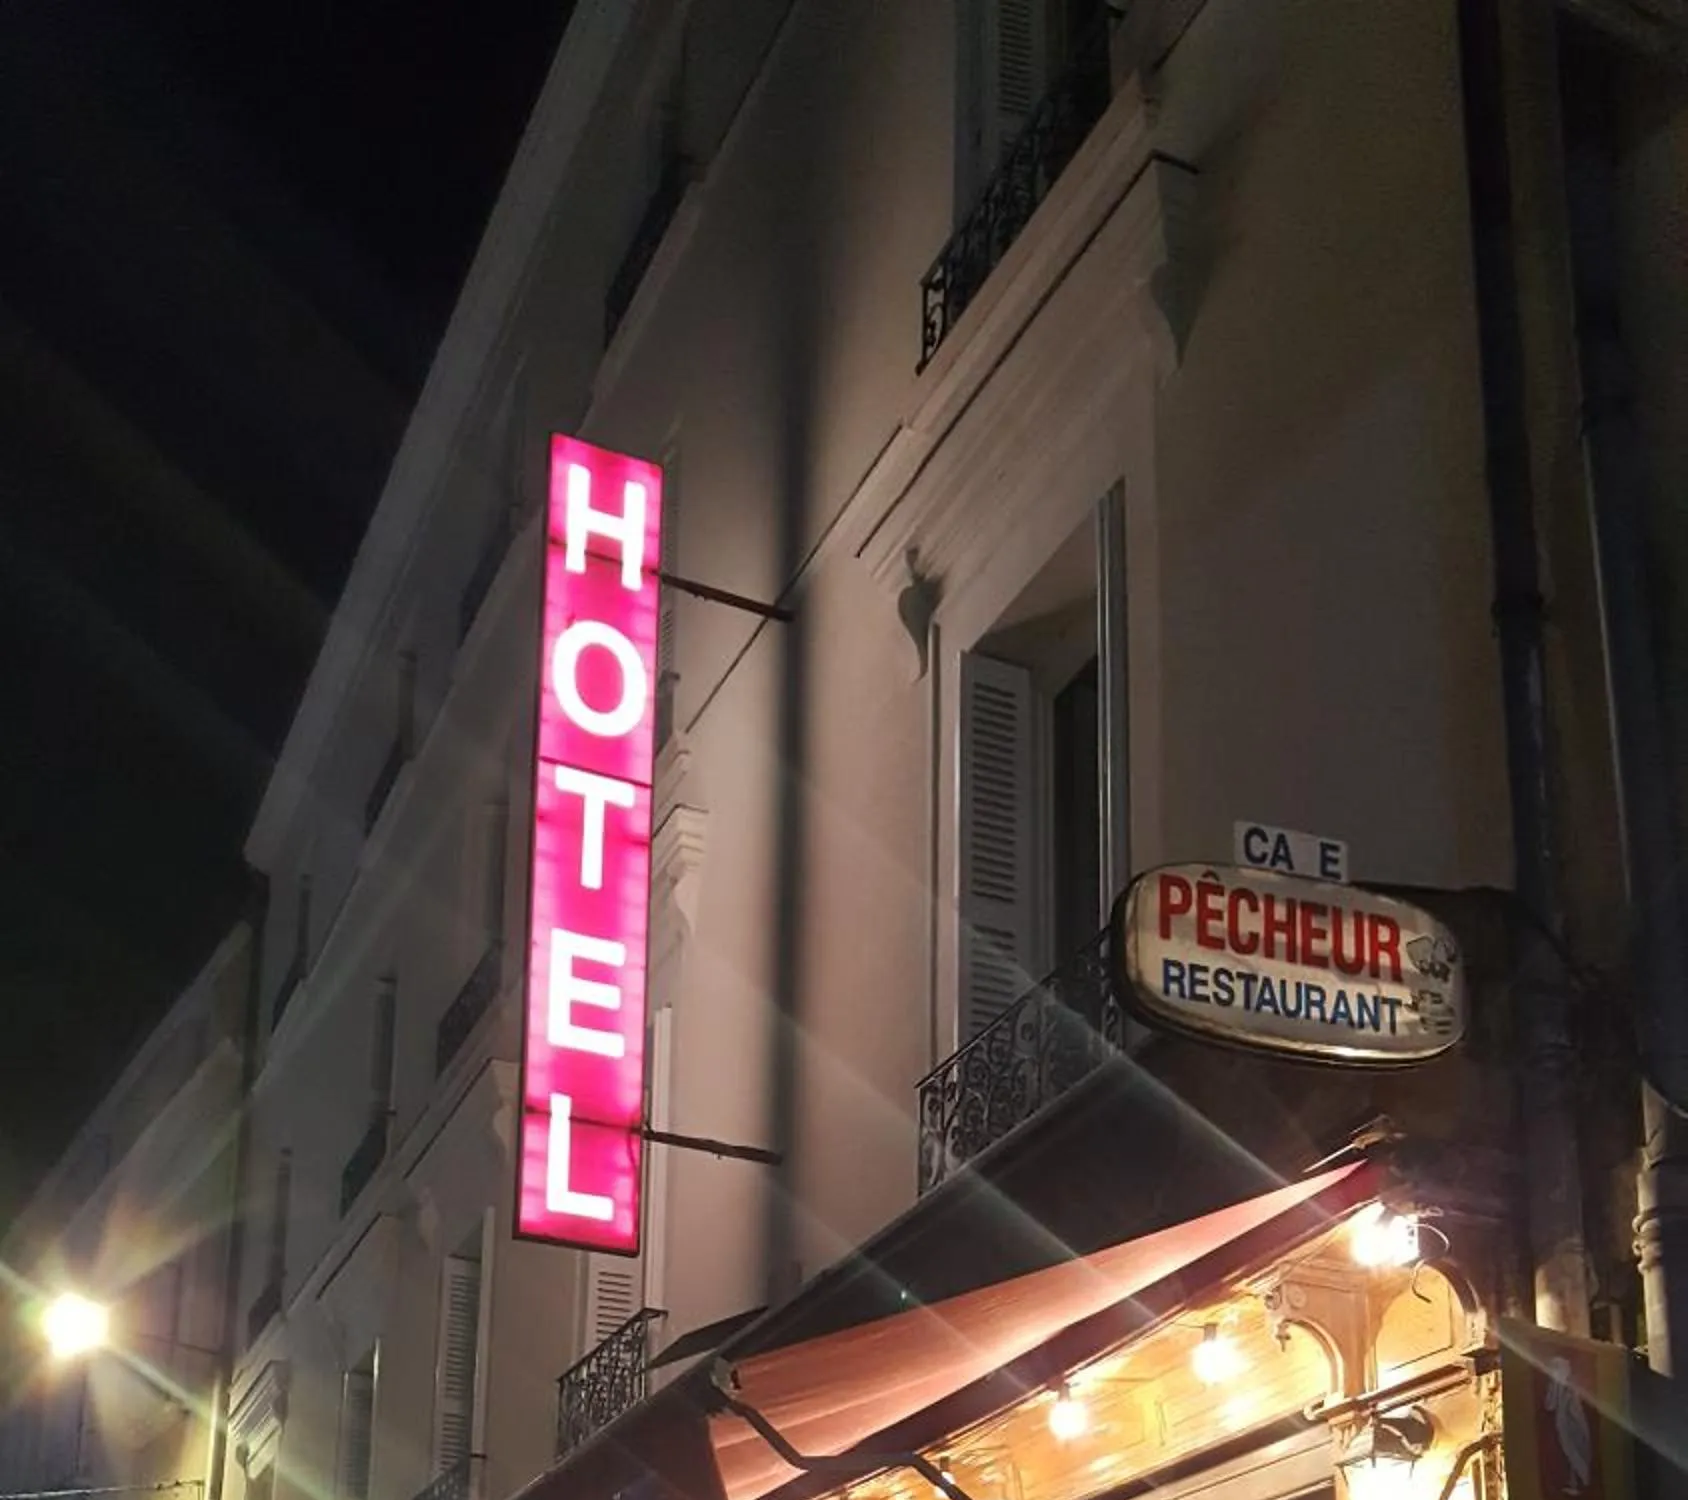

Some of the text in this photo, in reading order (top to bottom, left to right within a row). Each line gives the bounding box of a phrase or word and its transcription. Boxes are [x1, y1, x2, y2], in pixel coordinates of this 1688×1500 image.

[545, 462, 648, 1222] HOTEL
[1244, 827, 1342, 880] CAE
[1158, 870, 1403, 982] PÊCHEUR
[1163, 957, 1402, 1036] RESTAURANT
